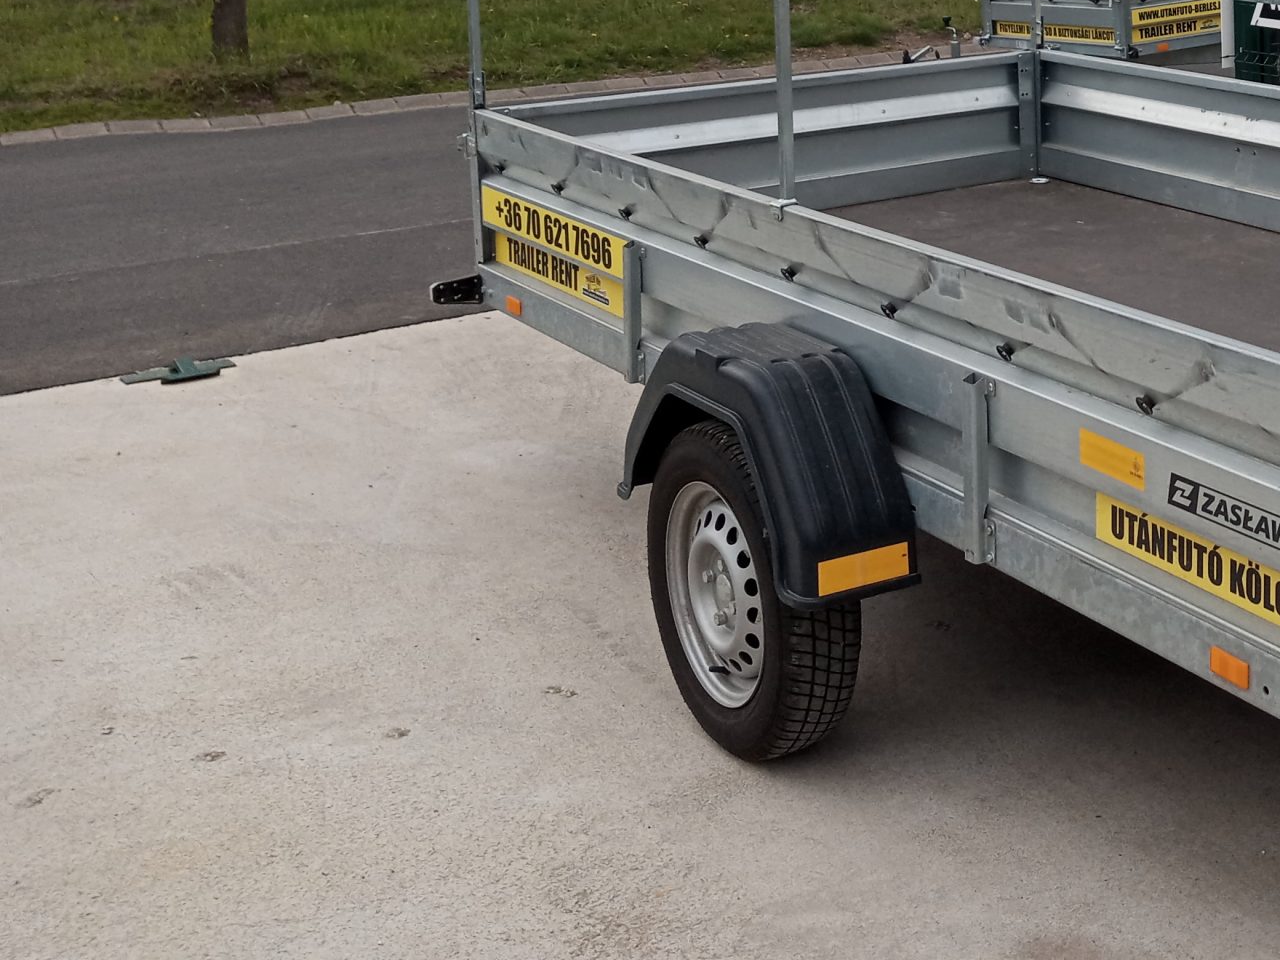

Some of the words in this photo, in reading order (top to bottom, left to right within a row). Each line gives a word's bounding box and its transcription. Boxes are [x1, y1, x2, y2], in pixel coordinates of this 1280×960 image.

[1138, 1, 1220, 21] WWW.UTANFUTO-BERLES.
[1138, 24, 1174, 39] TRAILER
[1176, 20, 1197, 34] RENT
[496, 198, 522, 232] +36
[524, 205, 541, 240] 70
[544, 214, 570, 252] 621
[572, 225, 612, 269] 7696
[507, 237, 549, 278] TRAILER
[551, 258, 580, 291] RENT
[1110, 503, 1223, 586] UTÁNFUTÓ
